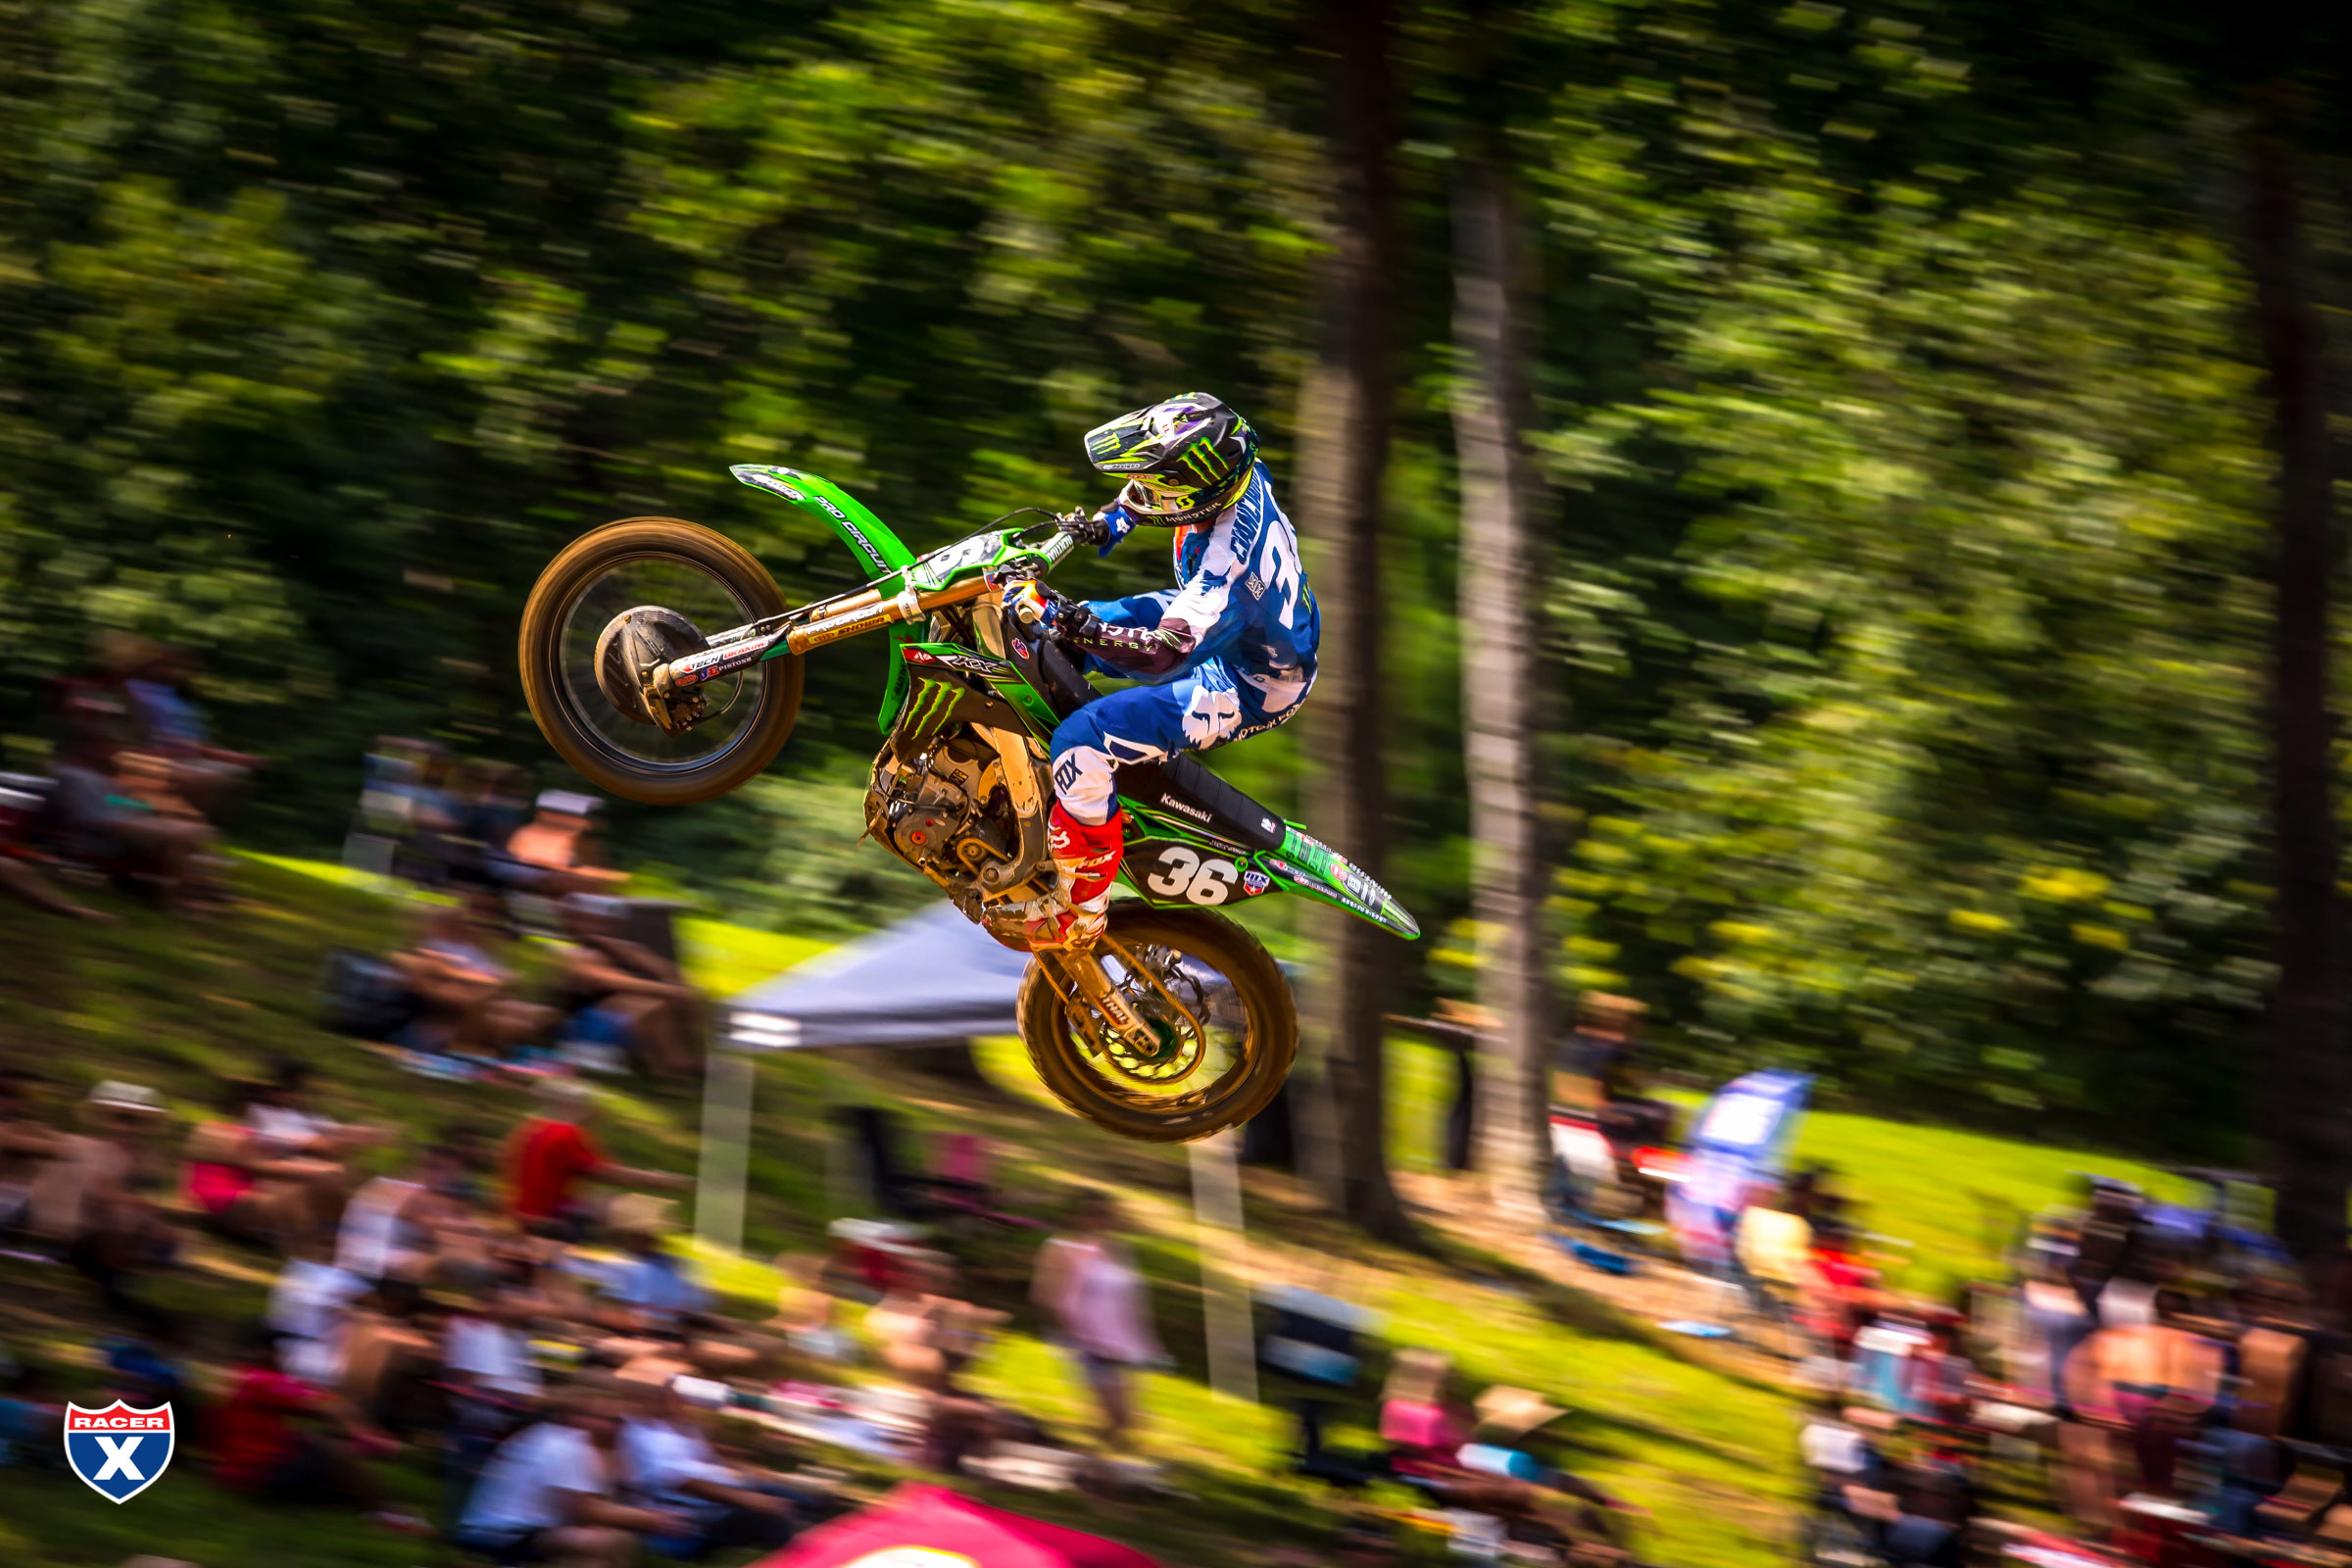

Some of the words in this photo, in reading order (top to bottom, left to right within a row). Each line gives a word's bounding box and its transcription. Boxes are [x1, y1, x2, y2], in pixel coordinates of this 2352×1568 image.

[1165, 501, 1223, 524] MONSTER
[812, 495, 848, 520] PRO
[841, 520, 894, 575] CIRCUIT
[718, 657, 753, 671] PISTONS
[1054, 752, 1084, 796] FOX
[1159, 792, 1213, 824] Kawasaki
[1078, 850, 1117, 869] FOX
[1148, 846, 1240, 906] 36
